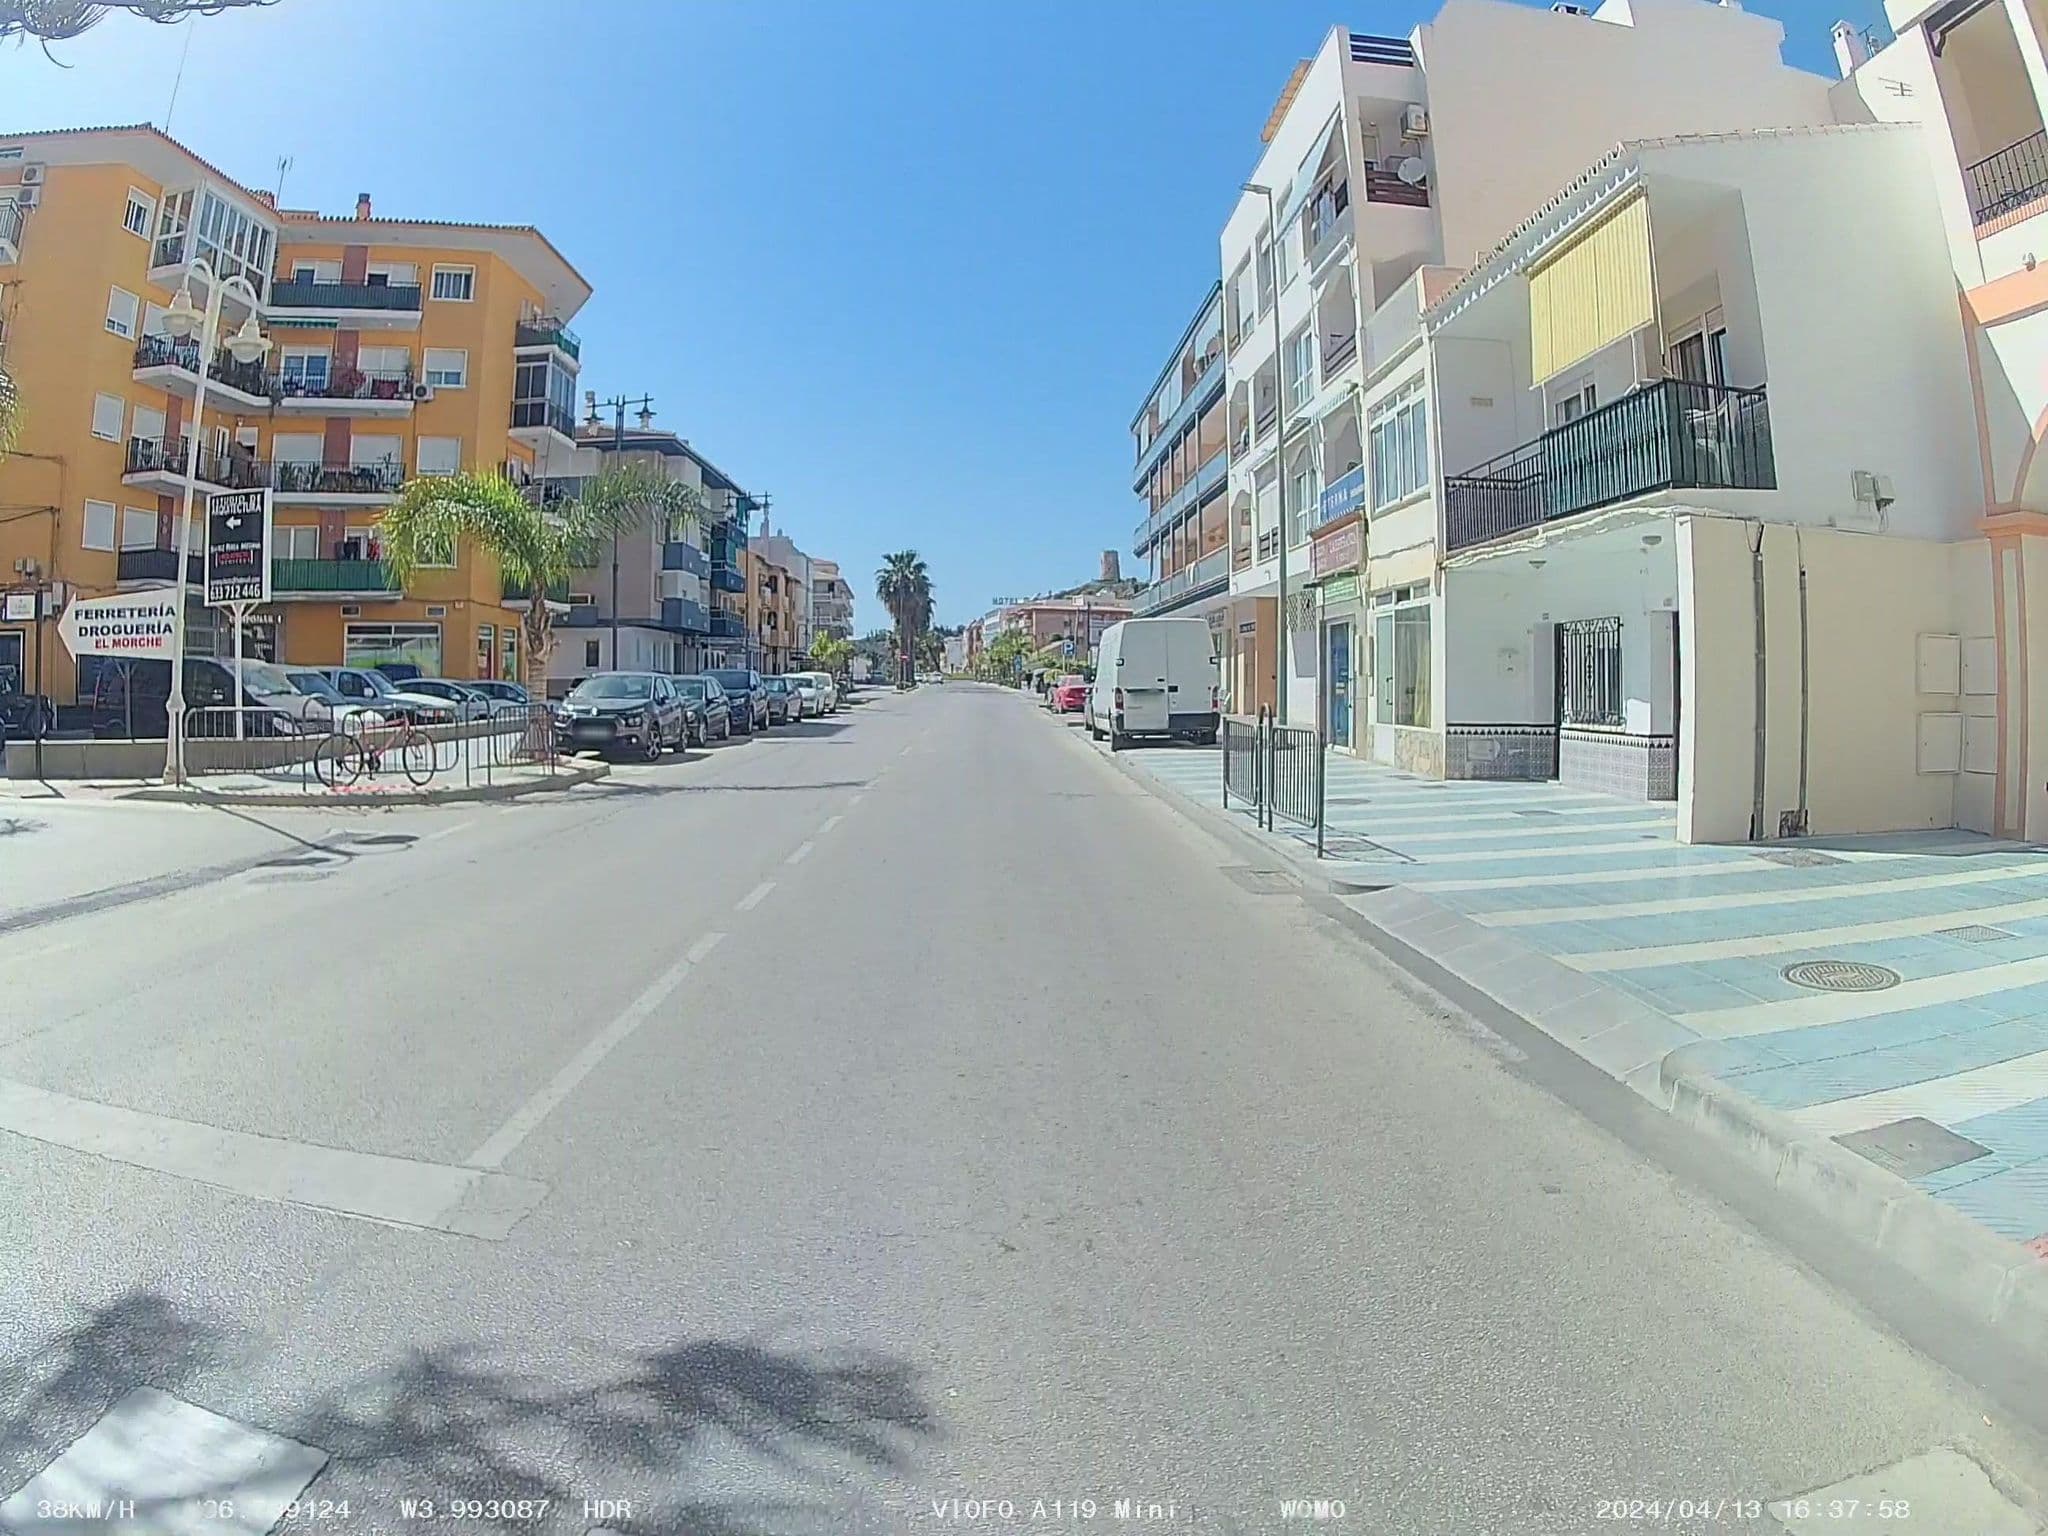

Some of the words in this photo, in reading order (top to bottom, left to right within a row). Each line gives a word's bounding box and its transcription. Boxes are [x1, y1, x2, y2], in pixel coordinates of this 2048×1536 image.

[224, 584, 241, 599] 712
[241, 583, 261, 598] 446
[74, 602, 176, 620] FERRETERÍA
[78, 620, 173, 637] DROGUERÍA
[94, 638, 110, 650] EL
[111, 636, 162, 649] MORCHE
